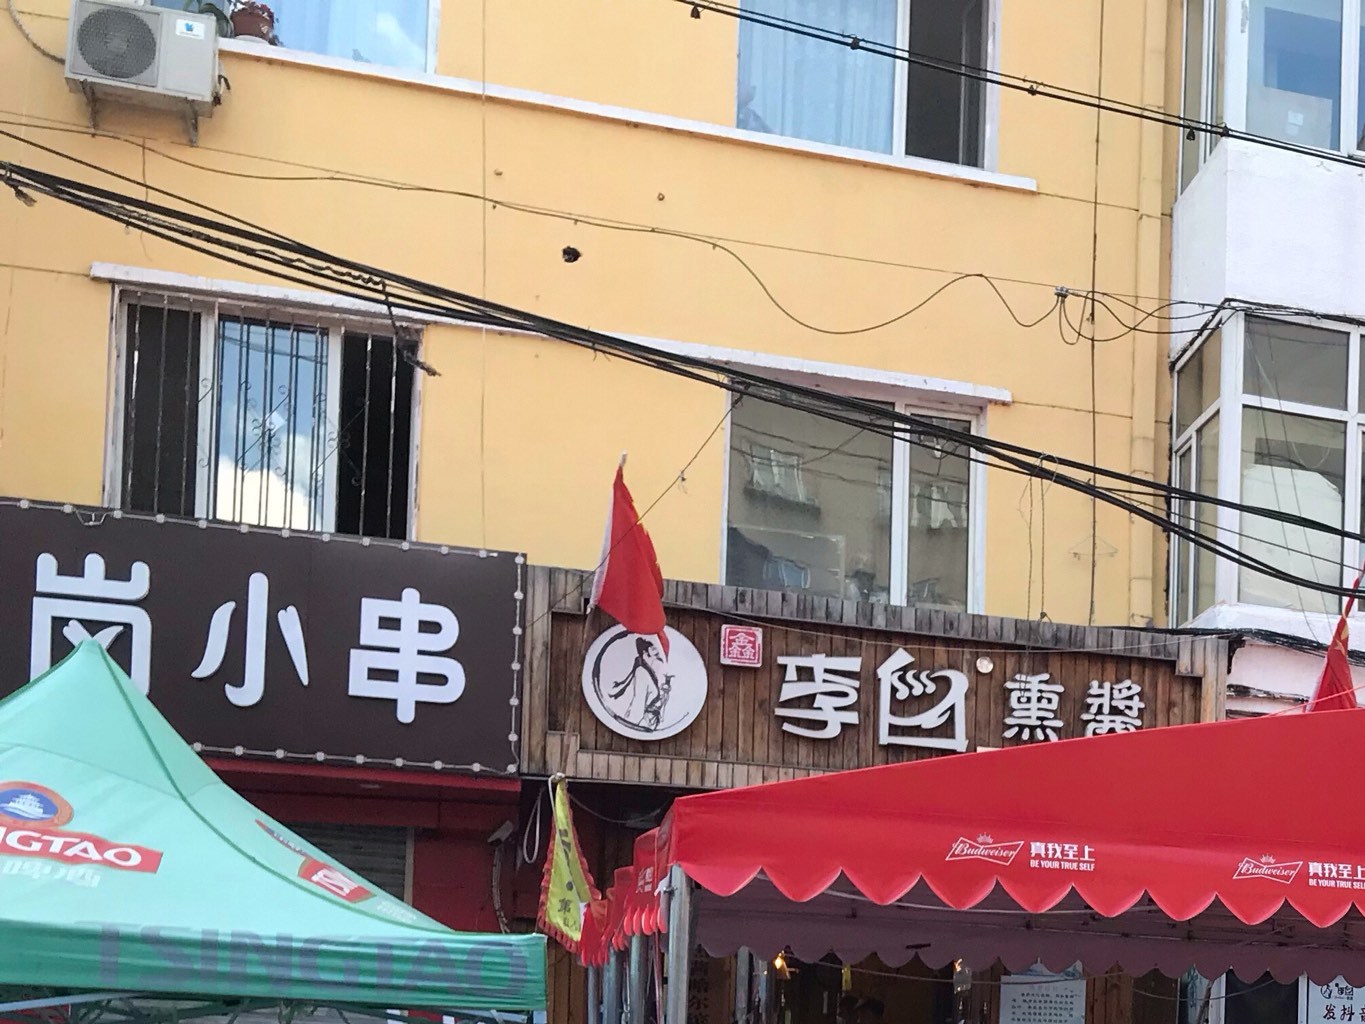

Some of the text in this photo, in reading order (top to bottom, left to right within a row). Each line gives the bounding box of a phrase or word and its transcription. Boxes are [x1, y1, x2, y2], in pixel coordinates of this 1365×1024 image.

[952, 843, 1016, 858] Budweiser
[1030, 841, 1095, 861] 真我至上
[1030, 860, 1095, 871] BE YOUR TRUE SELF
[1238, 862, 1296, 876] Budweiser
[1319, 880, 1336, 888] YOUR
[1336, 881, 1352, 889] TRUE
